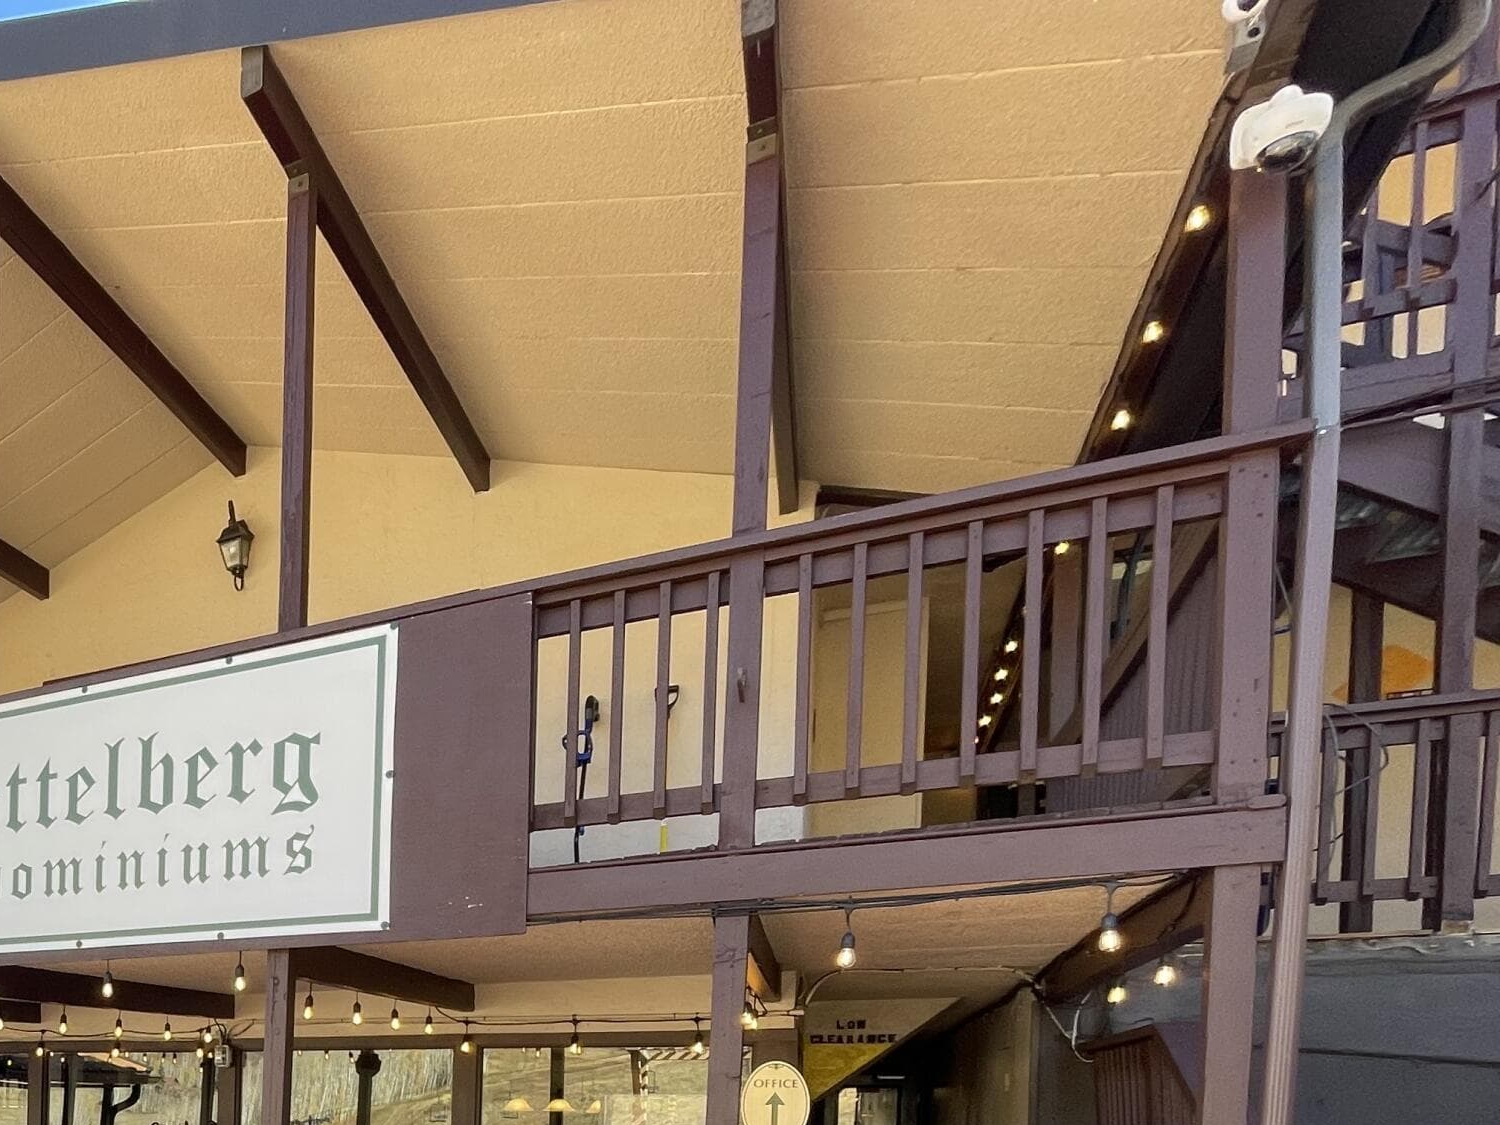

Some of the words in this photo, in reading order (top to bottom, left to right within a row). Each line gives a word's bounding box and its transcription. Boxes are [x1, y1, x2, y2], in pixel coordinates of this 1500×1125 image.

[836, 1019, 867, 1030] LOW
[809, 1033, 898, 1044] CLEARANCE
[753, 1079, 799, 1089] OFFICE
